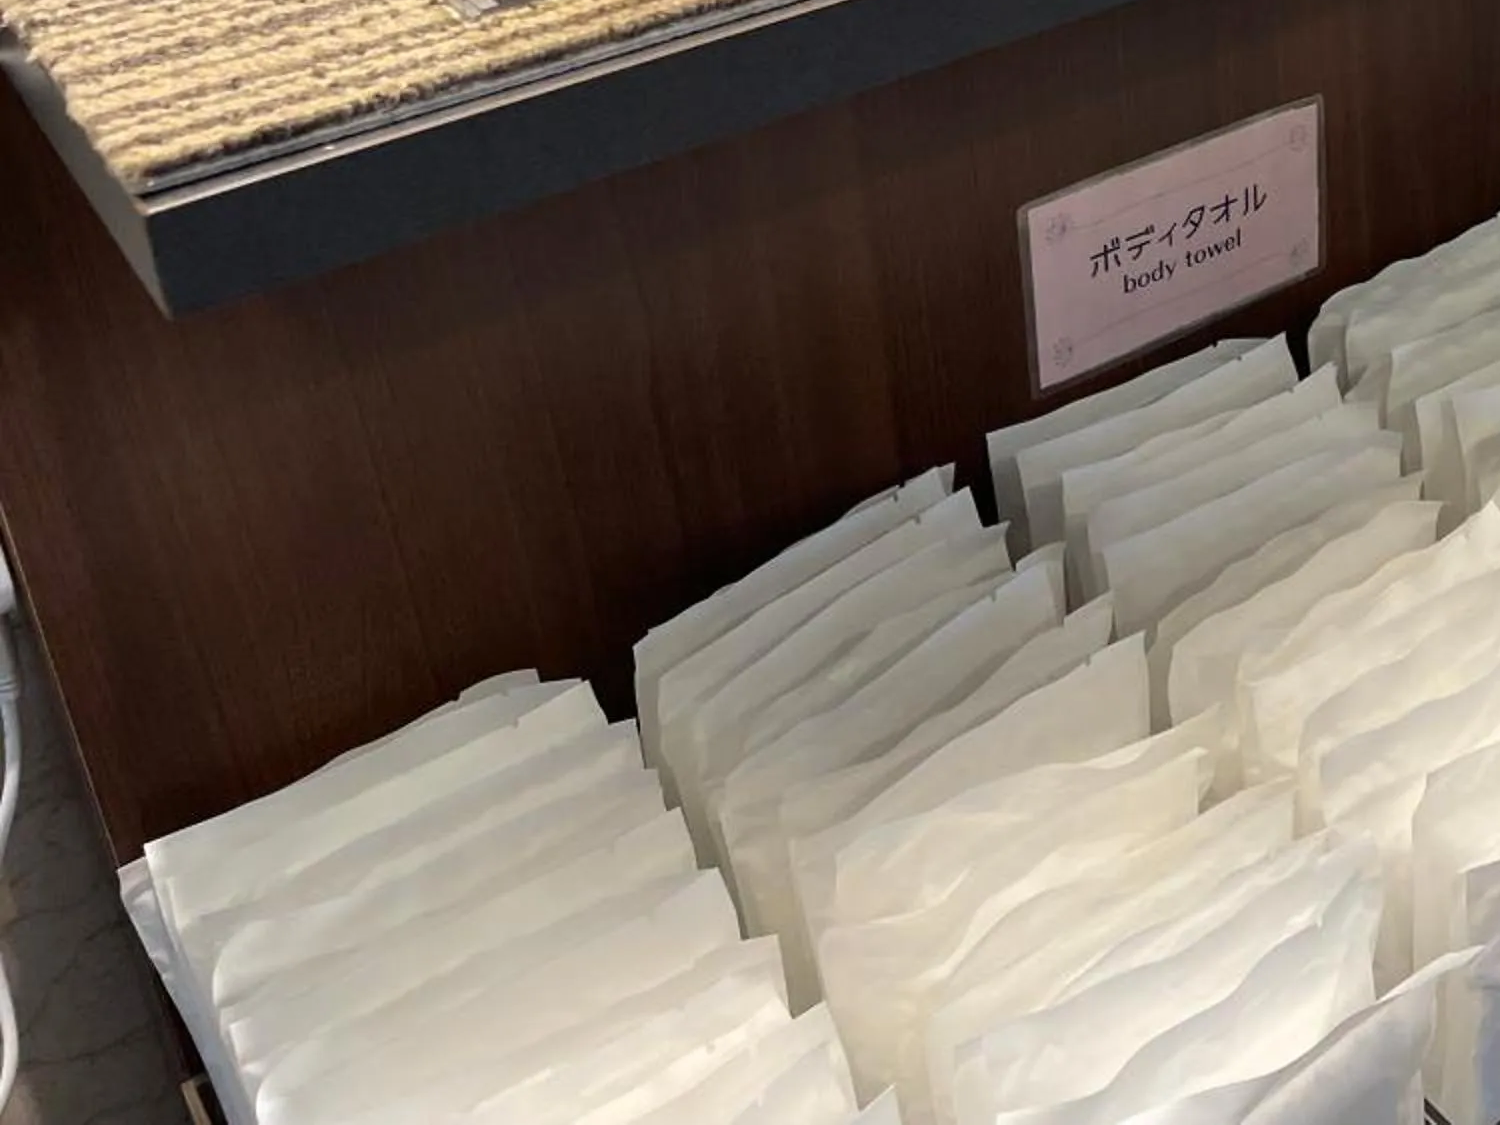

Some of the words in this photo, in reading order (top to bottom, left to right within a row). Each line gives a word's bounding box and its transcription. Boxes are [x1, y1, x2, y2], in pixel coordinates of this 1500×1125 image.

[1090, 184, 1267, 277] ボディタオル
[1123, 261, 1177, 294] body
[1185, 228, 1243, 268] towel
